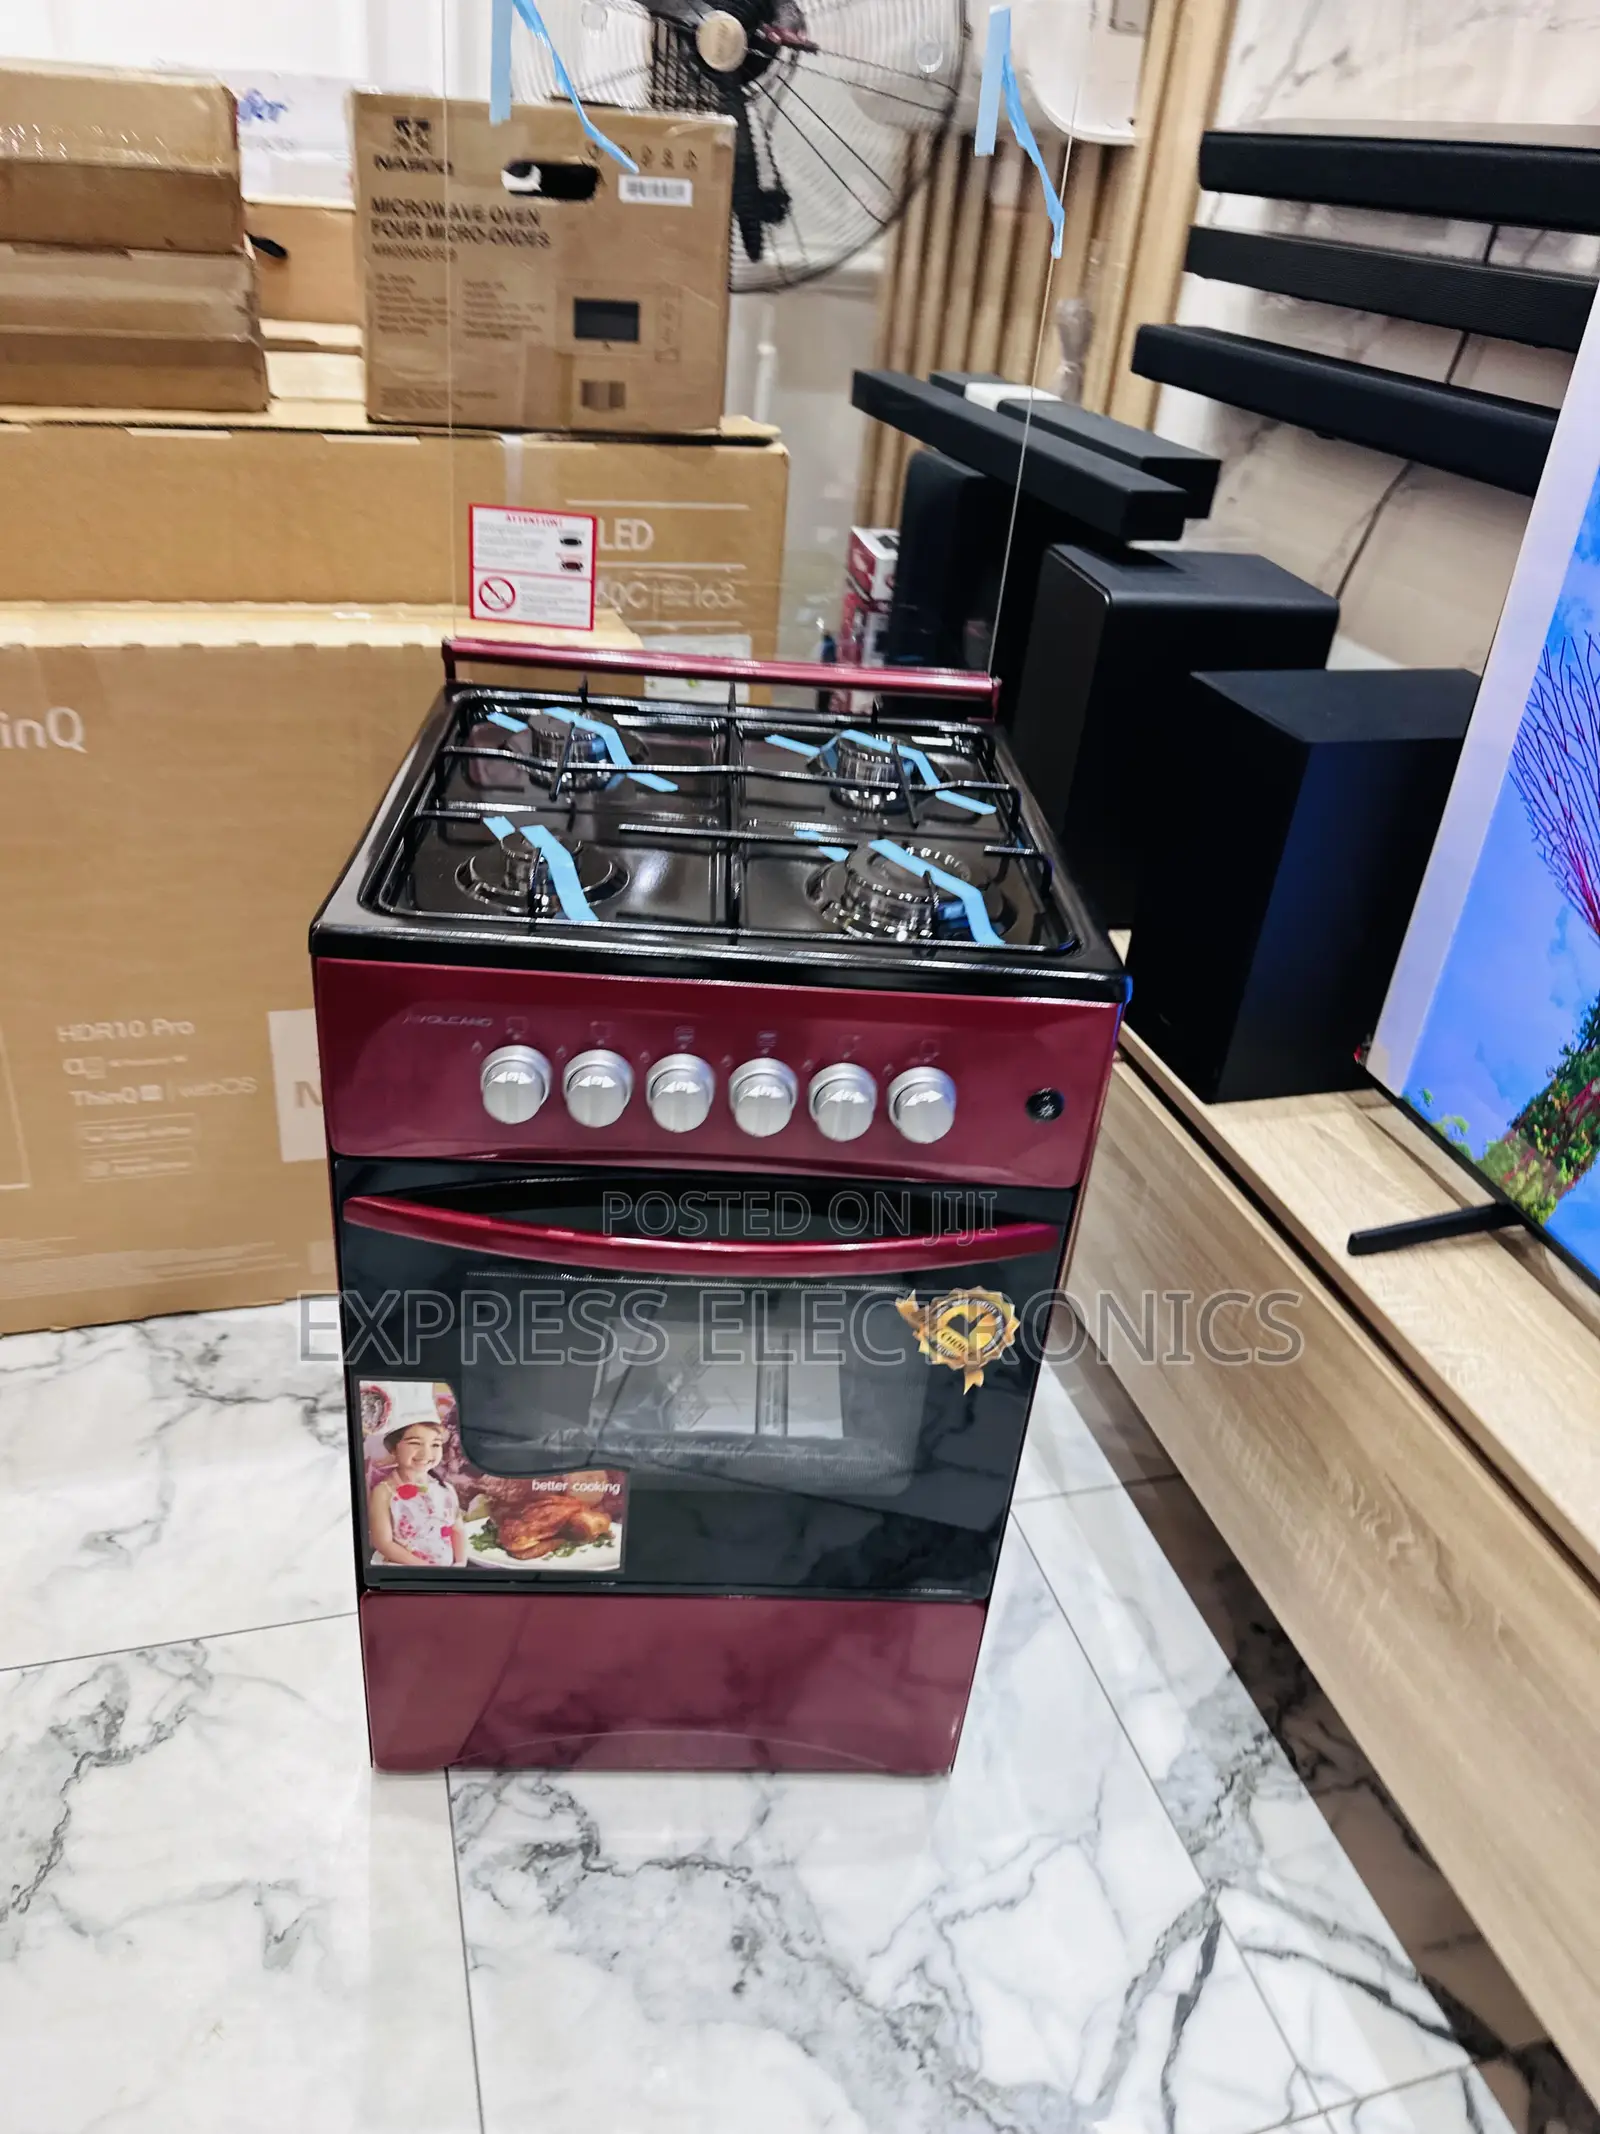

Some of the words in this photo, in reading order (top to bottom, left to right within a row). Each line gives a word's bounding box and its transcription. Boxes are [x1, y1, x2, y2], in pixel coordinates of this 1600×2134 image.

[371, 198, 485, 224] MICROWAVE
[488, 204, 541, 228] OVEN
[371, 219, 422, 239] FOUR
[56, 1019, 146, 1042] HDR10
[151, 1018, 196, 1036] Pro
[531, 1479, 568, 1491] better
[572, 1480, 621, 1496] cooking
